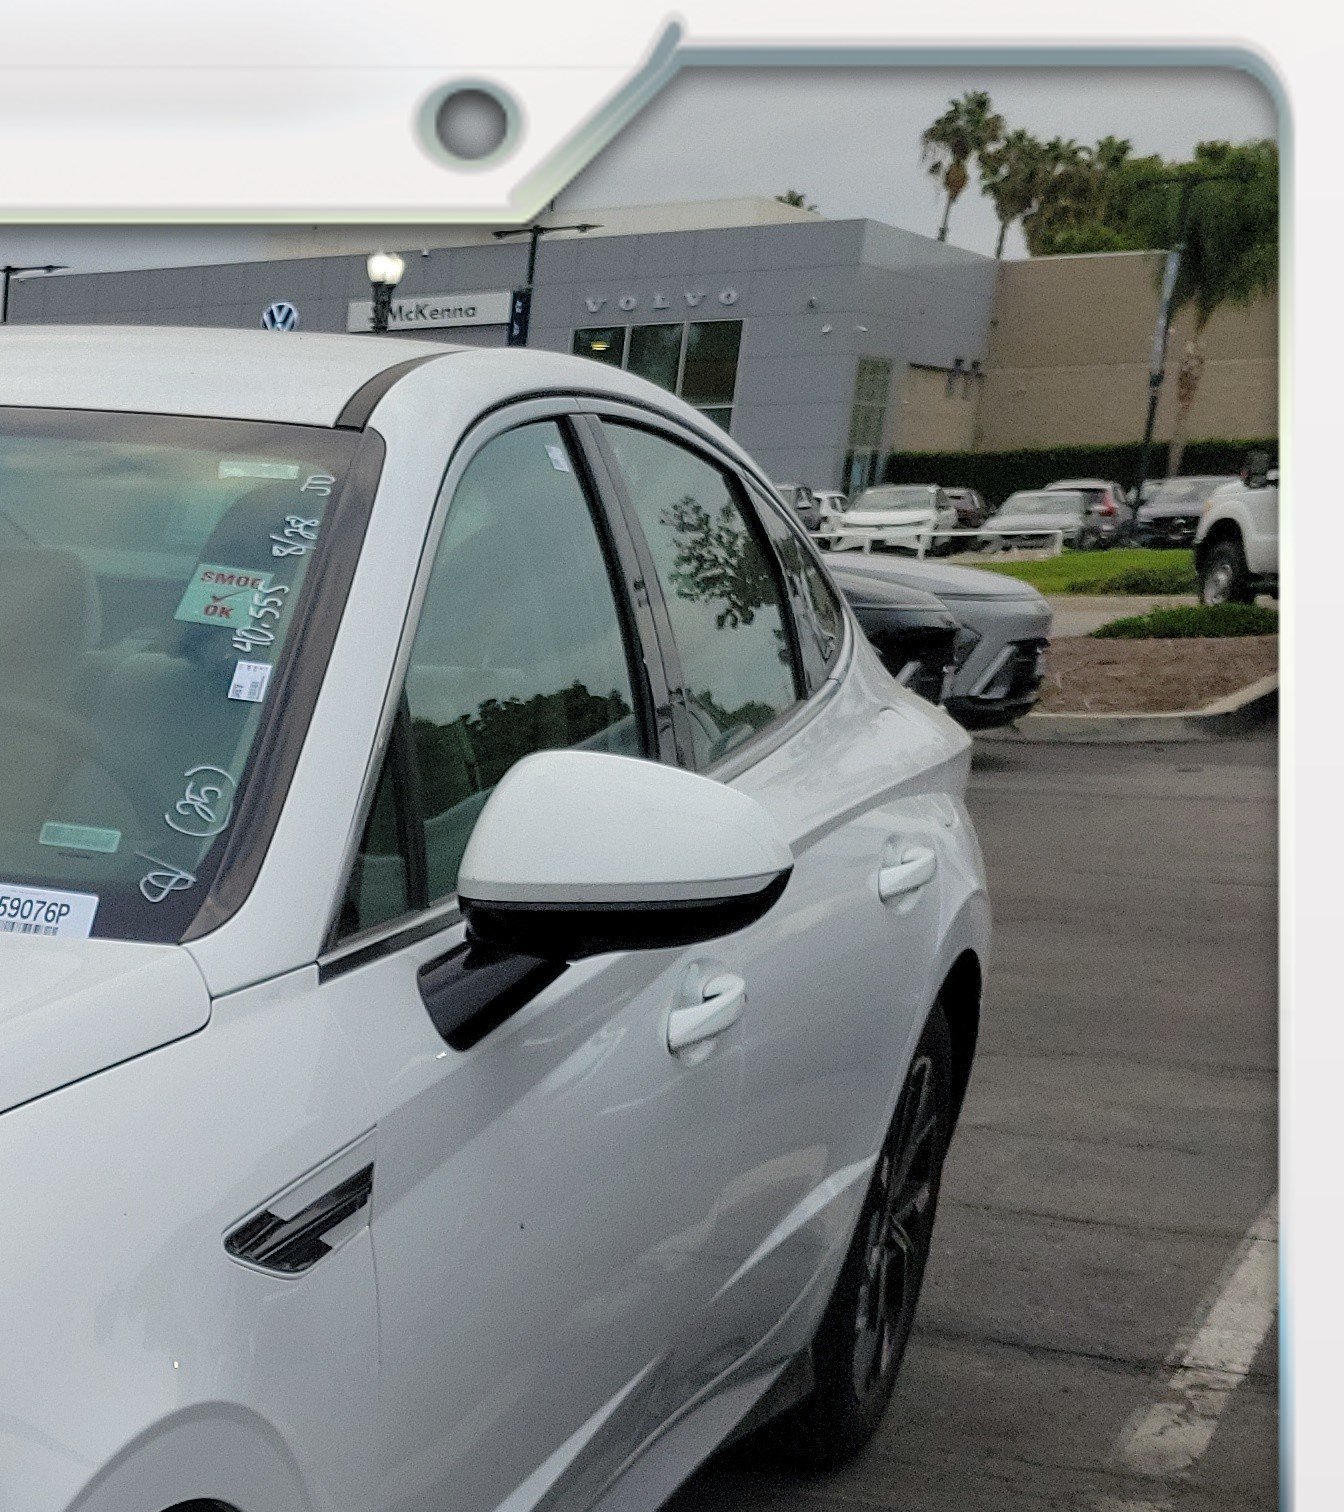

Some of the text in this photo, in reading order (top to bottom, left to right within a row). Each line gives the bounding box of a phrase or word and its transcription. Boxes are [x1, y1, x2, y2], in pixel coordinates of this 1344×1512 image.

[584, 289, 739, 313] VOLVO
[387, 303, 477, 322] McKenna
[269, 514, 321, 557] 8/28
[203, 604, 234, 619] OK
